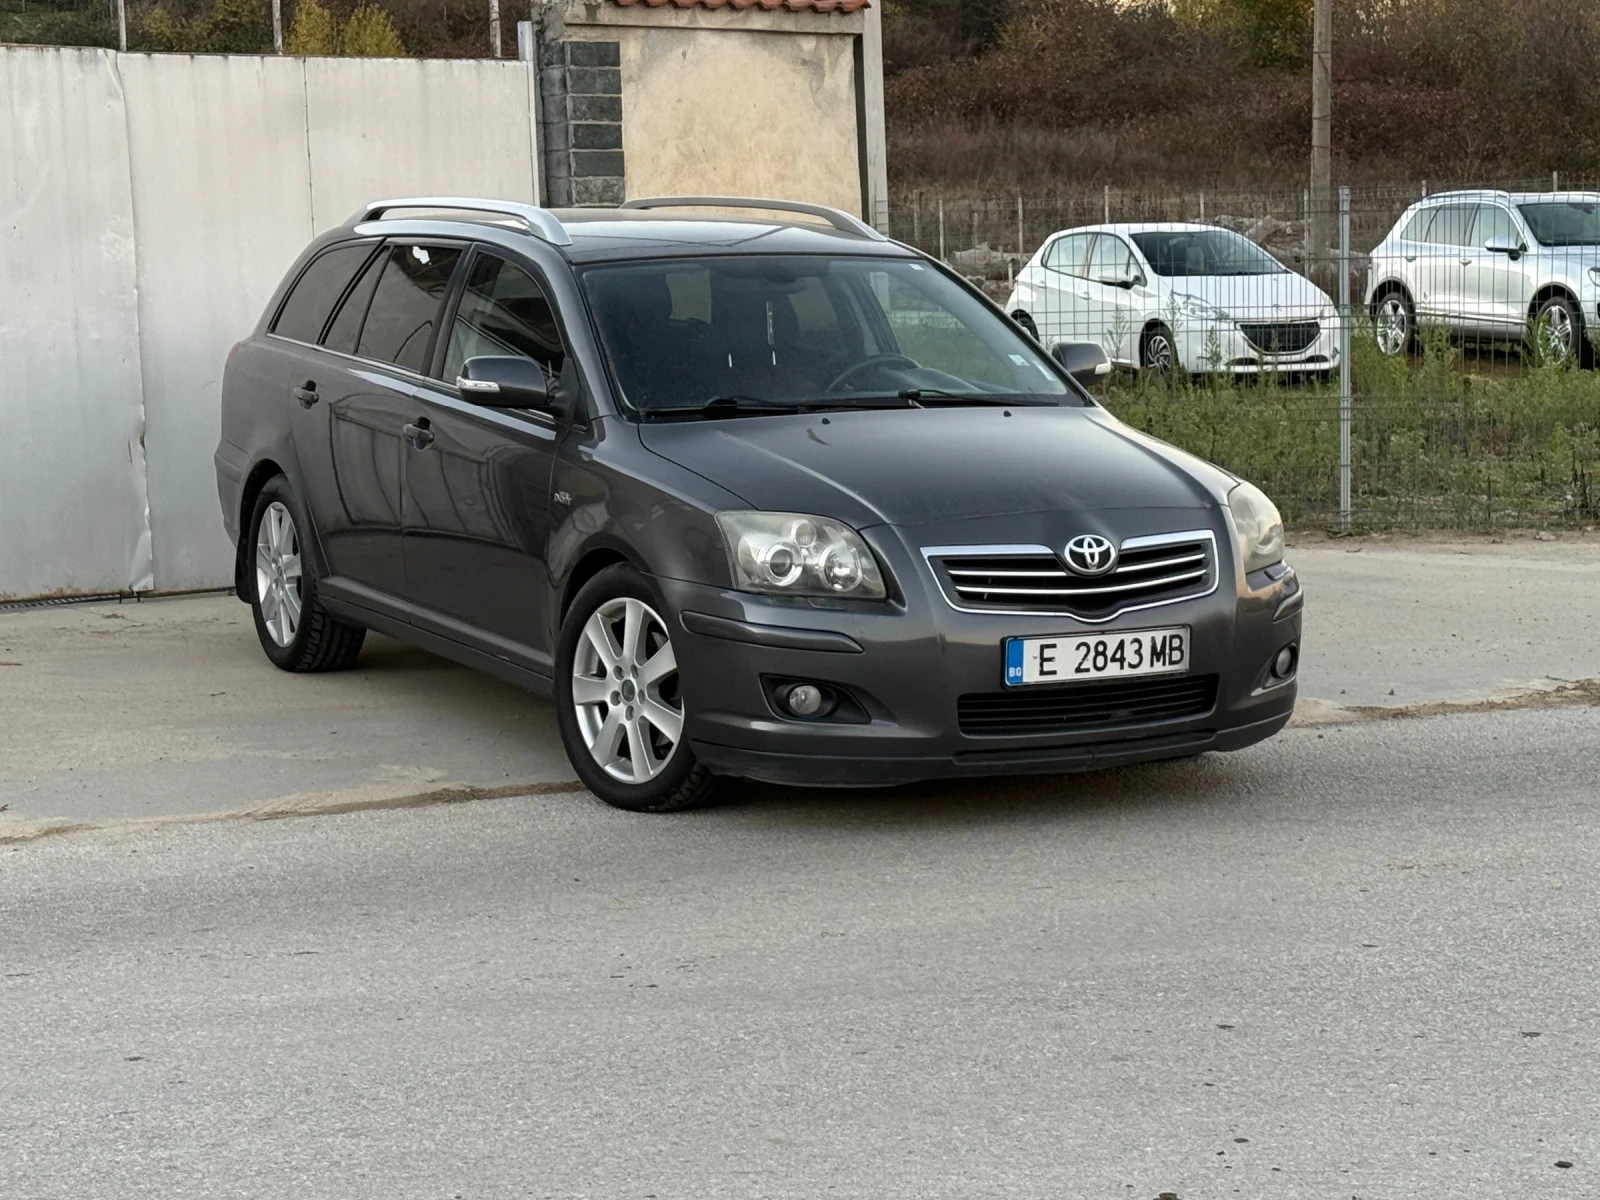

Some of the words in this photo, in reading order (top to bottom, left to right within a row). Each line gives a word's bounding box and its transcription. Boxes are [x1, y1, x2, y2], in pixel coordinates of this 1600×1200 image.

[1039, 643, 1057, 676] E
[1074, 637, 1143, 673] 2843
[1150, 634, 1184, 668] MB
[1008, 667, 1022, 677] BG
